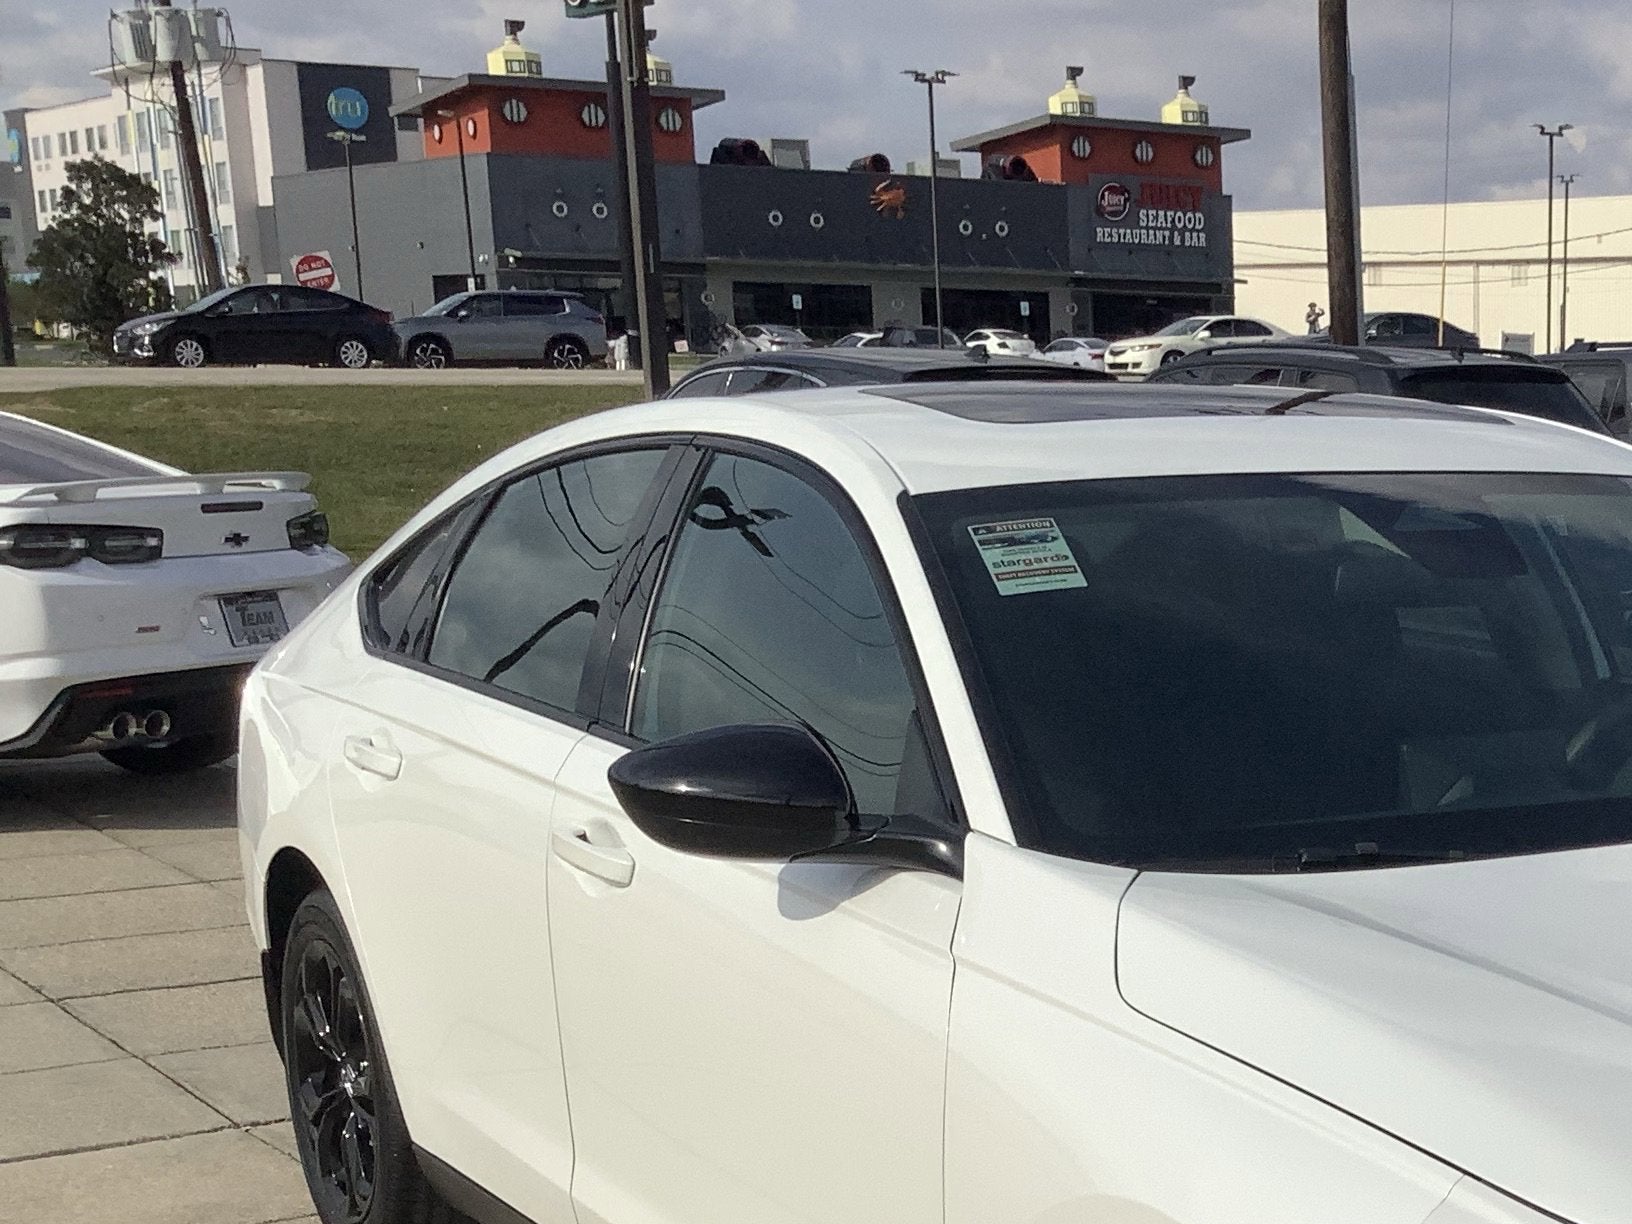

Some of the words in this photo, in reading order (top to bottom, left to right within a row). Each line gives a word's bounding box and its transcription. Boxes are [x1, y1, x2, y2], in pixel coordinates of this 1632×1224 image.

[327, 92, 361, 117] tru
[1139, 209, 1205, 230] SEAFOOD
[1096, 227, 1170, 245] RESTAURANT
[1173, 230, 1181, 246] &
[1184, 231, 1206, 247] BAR
[299, 263, 309, 272] DO
[311, 259, 326, 268] NOT
[996, 520, 1050, 532] ATTENTION
